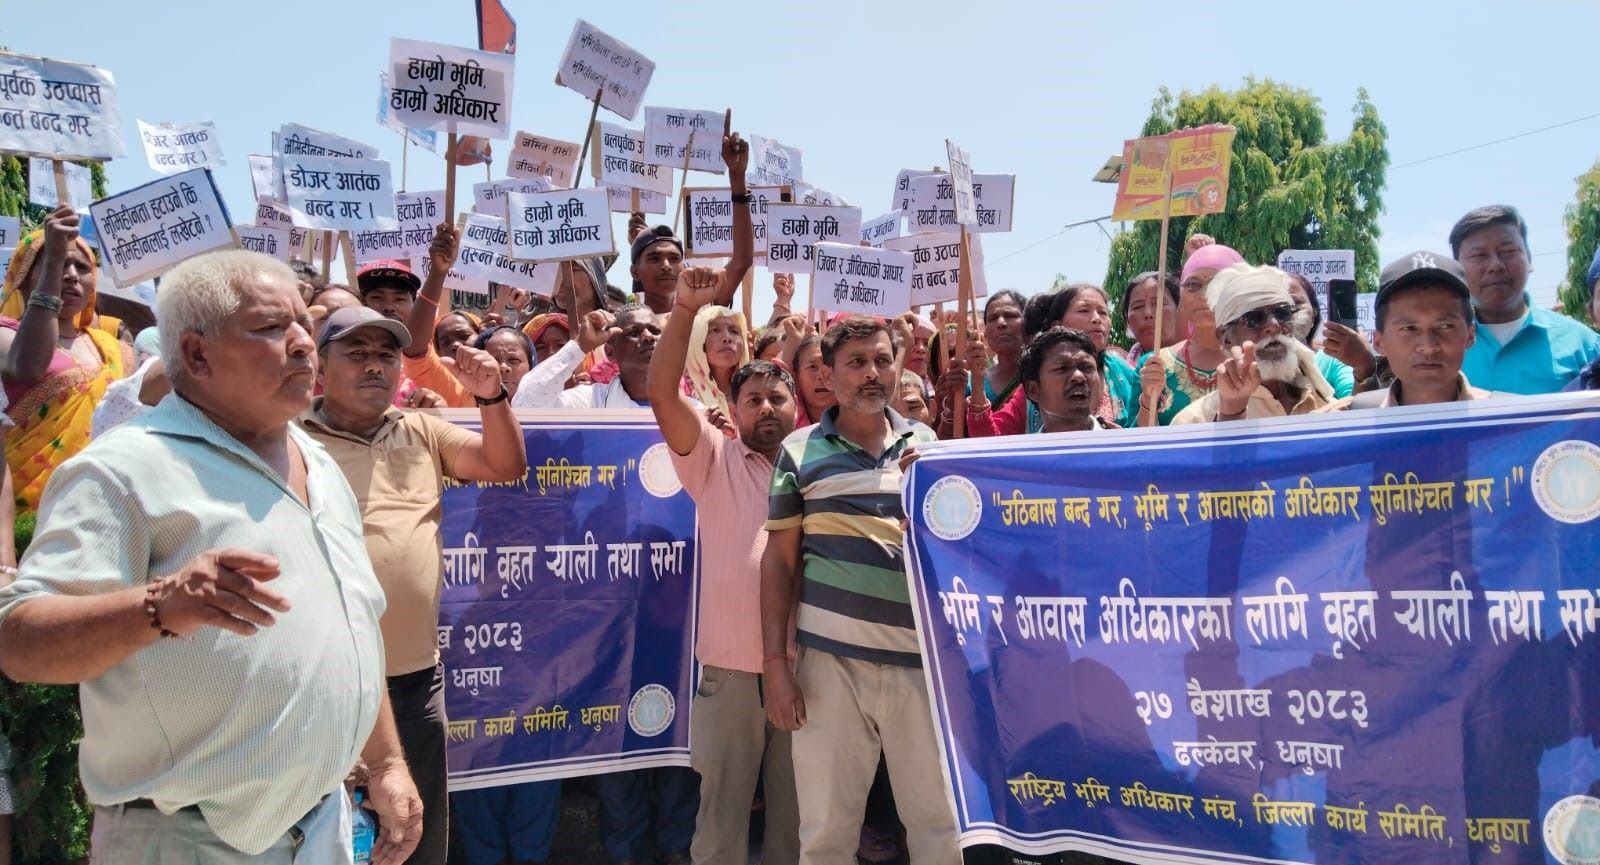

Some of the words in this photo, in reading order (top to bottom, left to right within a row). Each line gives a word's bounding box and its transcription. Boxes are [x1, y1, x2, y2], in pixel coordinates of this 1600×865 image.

[408, 54, 446, 82] हाम्रो
[451, 59, 487, 91] भूमि,
[390, 85, 428, 112] हाम्रो
[434, 89, 501, 123] अधिकार
[29, 110, 63, 134] बन्द
[67, 114, 92, 137] गर
[666, 113, 687, 128] हाम्रो
[604, 132, 635, 154] बलपूर्वक
[655, 142, 674, 158] हाम्रो
[178, 151, 198, 165] गर
[630, 160, 645, 177] बन्द
[647, 163, 660, 179] गर
[289, 164, 331, 190] डोजर
[336, 170, 380, 192] आतंक
[101, 204, 152, 240] भूमिहीनता
[150, 185, 184, 219] हटाउने
[305, 199, 335, 218] बन्द
[339, 201, 362, 219] गर
[369, 201, 374, 219] ।
[397, 198, 422, 222] हटाउने
[525, 201, 553, 223] हाम्रो
[558, 197, 587, 224] भूमि,
[695, 196, 731, 221] भूमिहीनता
[112, 225, 169, 269] भूमिहीनलाई
[206, 213, 214, 232] ?
[468, 223, 508, 246] बलपूर्वक
[514, 226, 542, 248] हाम्रो
[548, 223, 601, 245] अधिकार
[695, 221, 733, 247] भूमिहीनला
[782, 215, 809, 237] हाम्रो
[813, 216, 841, 241] भूमि,
[770, 239, 798, 262] हाम्रो
[817, 250, 837, 272] जिवन
[838, 259, 844, 275] र
[846, 254, 881, 281] जीविकाको
[882, 263, 904, 284] आधार
[926, 270, 947, 287] बन्द
[833, 279, 849, 304] भूमि
[850, 281, 879, 306] अधिकार
[536, 458, 592, 496] सुनिश्चित
[598, 465, 617, 491] गर
[1063, 497, 1091, 528] बन्द
[1097, 496, 1127, 530] गर,
[1134, 483, 1168, 532] भूमि
[1175, 493, 1190, 527] र
[1198, 481, 1276, 523] आवासको
[1285, 476, 1361, 521] अधिकार
[1369, 471, 1455, 525] सुनिश्चित
[1463, 478, 1495, 513] गर
[442, 531, 488, 590] लागि
[496, 545, 537, 599] वृहत
[607, 542, 642, 582] तथा
[650, 540, 687, 581] सभा
[939, 576, 982, 646] भूमि
[987, 595, 1008, 646] र
[1015, 596, 1087, 648] आवास
[1099, 577, 1232, 651] अधिकारका
[1242, 576, 1309, 646] लागि
[1320, 590, 1379, 660] वृहत
[1485, 590, 1545, 646] तथा
[464, 622, 523, 655] २०८३
[452, 667, 503, 696] धनुषा
[1134, 690, 1172, 726] २७
[1186, 677, 1272, 721] बैशाख
[1288, 689, 1369, 728] २०८३
[484, 710, 516, 737] कार्य
[524, 704, 572, 734] समिति,
[581, 704, 621, 732] धनुषा
[1173, 734, 1264, 772] ढल्केवर,
[1276, 740, 1344, 776] धनुषा
[1007, 772, 1067, 807] राष्ट्रिय
[1073, 777, 1111, 808] भूमि
[1119, 781, 1196, 820] अधिकार
[1202, 795, 1243, 828] मंच,
[1252, 792, 1317, 827] जिल्ला
[1324, 802, 1369, 834] कार्य
[1377, 804, 1453, 848] समिति,
[1465, 818, 1531, 854] धनुषा
